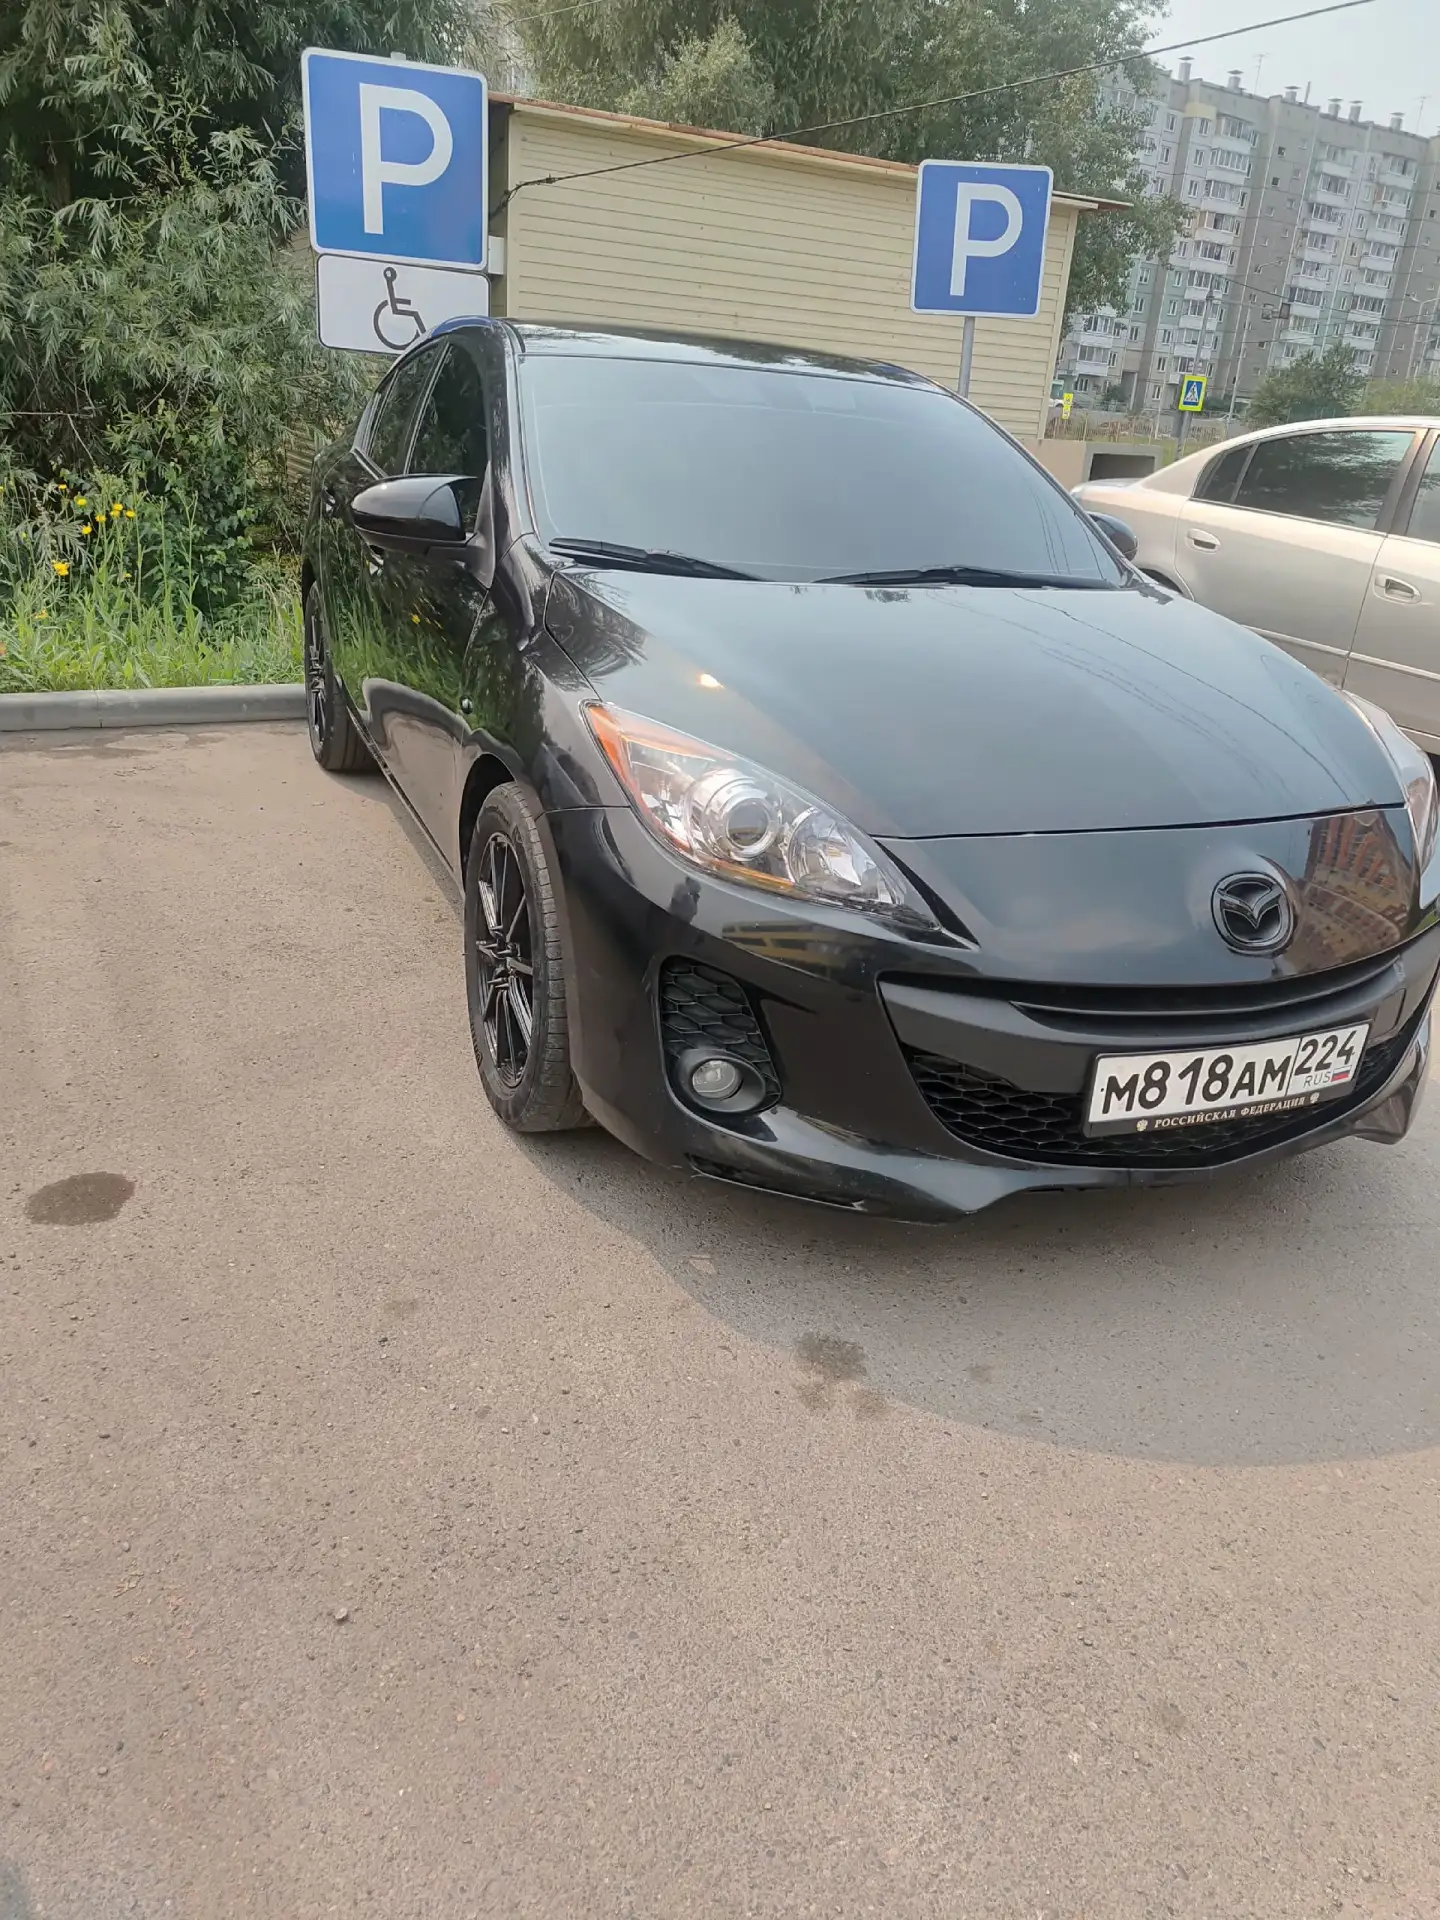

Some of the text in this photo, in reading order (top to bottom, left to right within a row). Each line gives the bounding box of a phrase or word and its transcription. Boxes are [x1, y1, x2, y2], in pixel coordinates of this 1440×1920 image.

[360, 83, 453, 235] P
[950, 182, 1023, 296] P
[1294, 1030, 1357, 1076] 224
[1303, 1071, 1331, 1088] RUS
[1154, 1097, 1305, 1128] РОССИЙСКАЯ ФЕДЕРАЦИЯ
